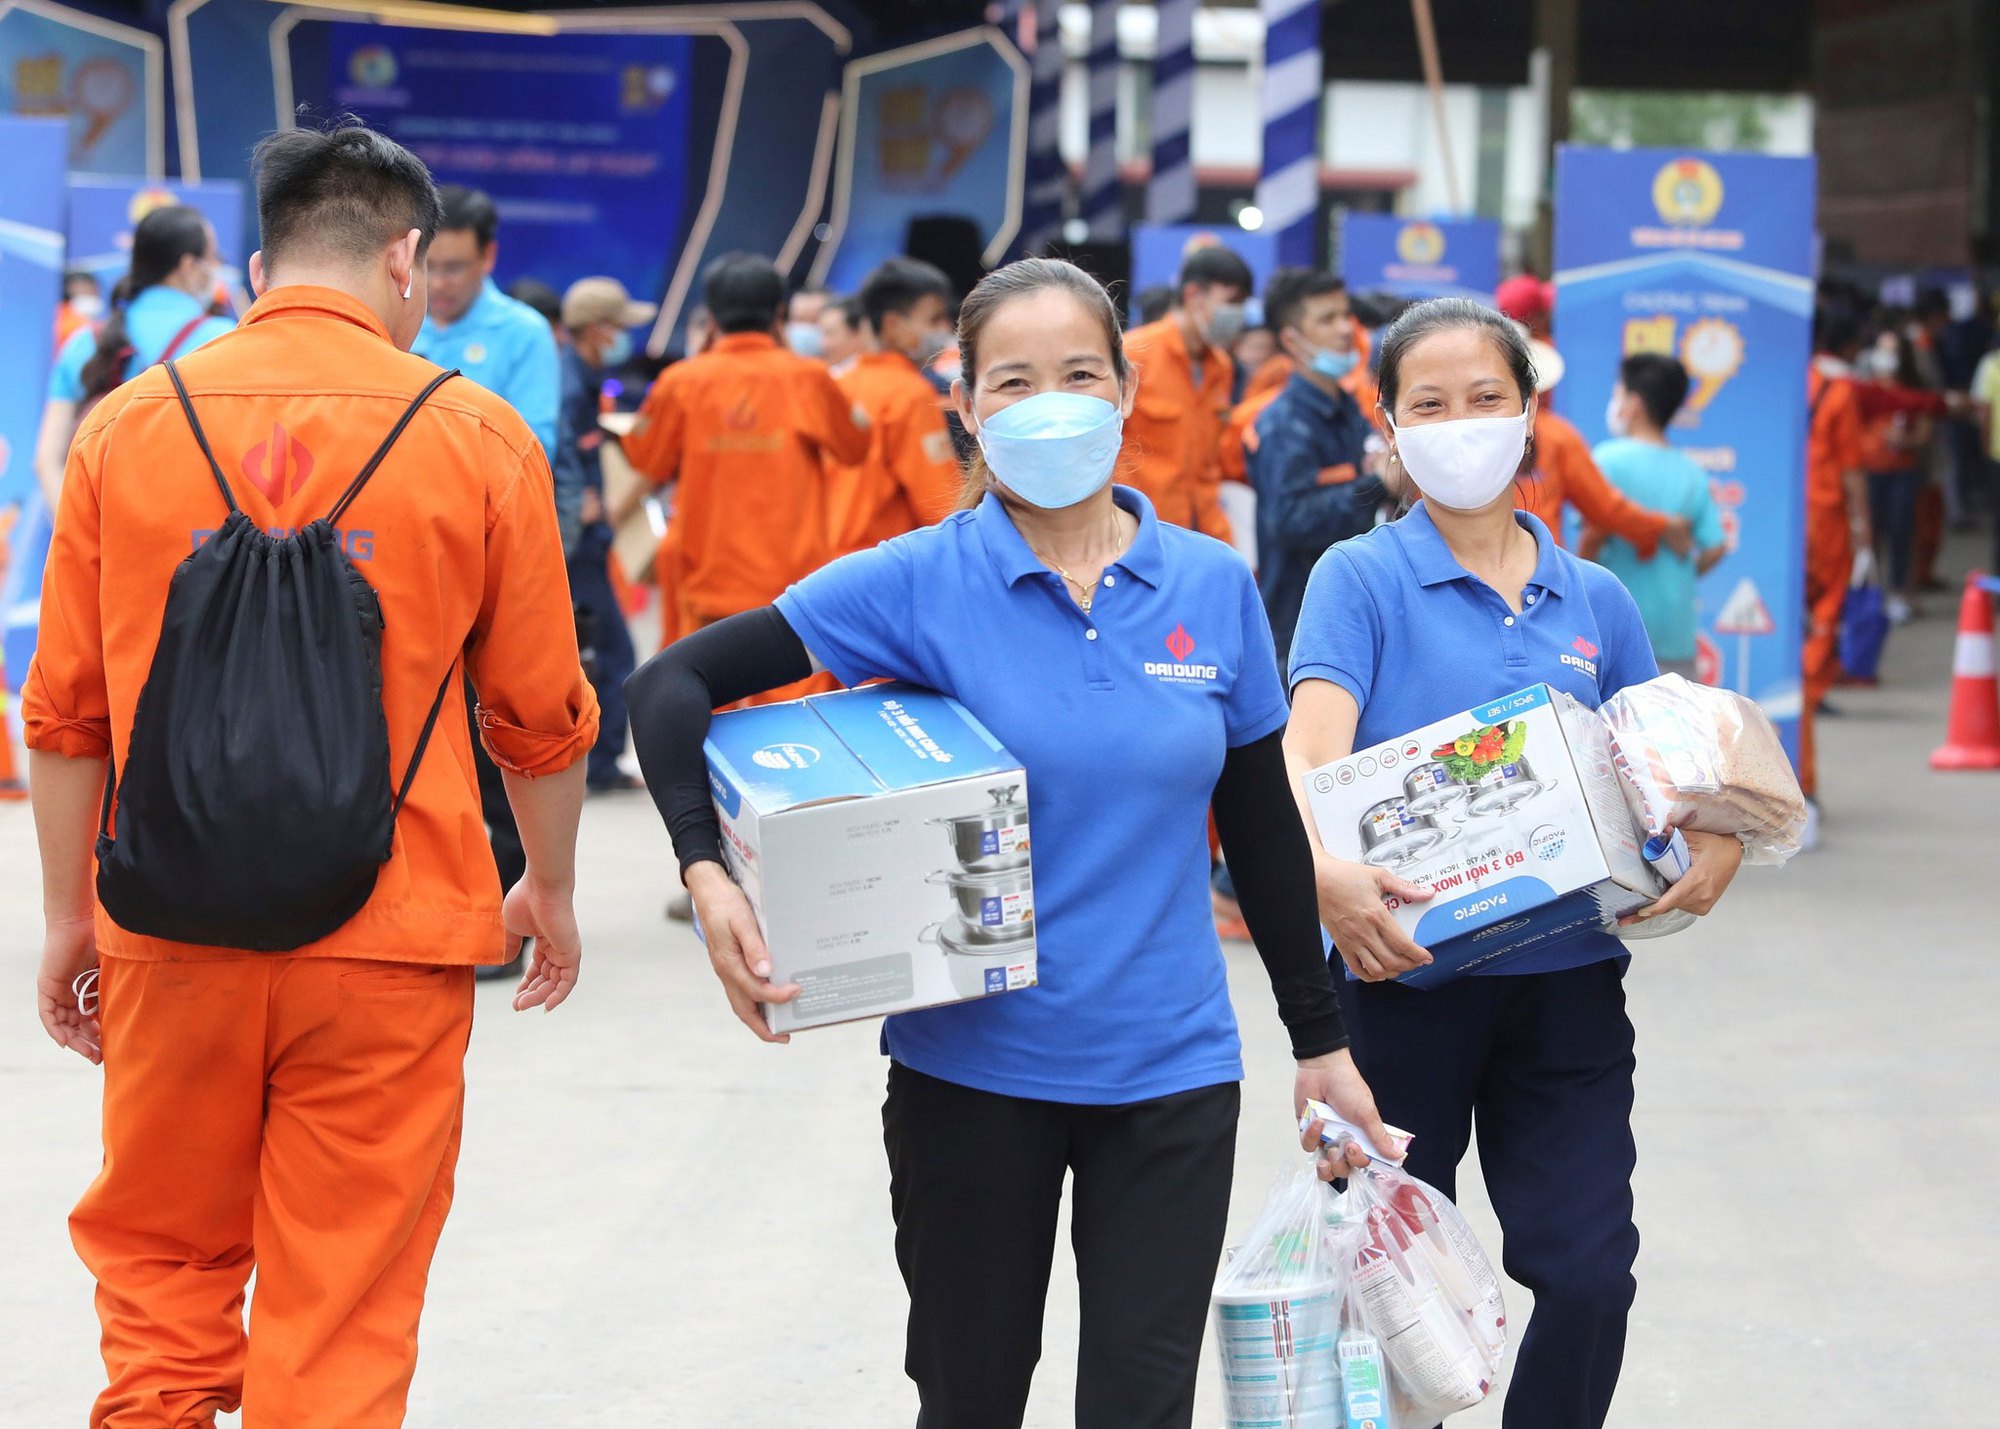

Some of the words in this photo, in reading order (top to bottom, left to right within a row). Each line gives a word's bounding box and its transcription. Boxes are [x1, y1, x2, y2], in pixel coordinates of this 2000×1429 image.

[1560, 654, 1597, 675] DAIDU
[1513, 694, 1535, 707] 3PCS
[1487, 706, 1501, 718] SET
[1532, 829, 1566, 846] PACIFIC
[1440, 862, 1460, 875] 16CM
[1492, 859, 1502, 871] 3
[1466, 864, 1490, 884] NỒI
[1431, 873, 1463, 894] INOX
[1453, 893, 1508, 921] PACIFIC
